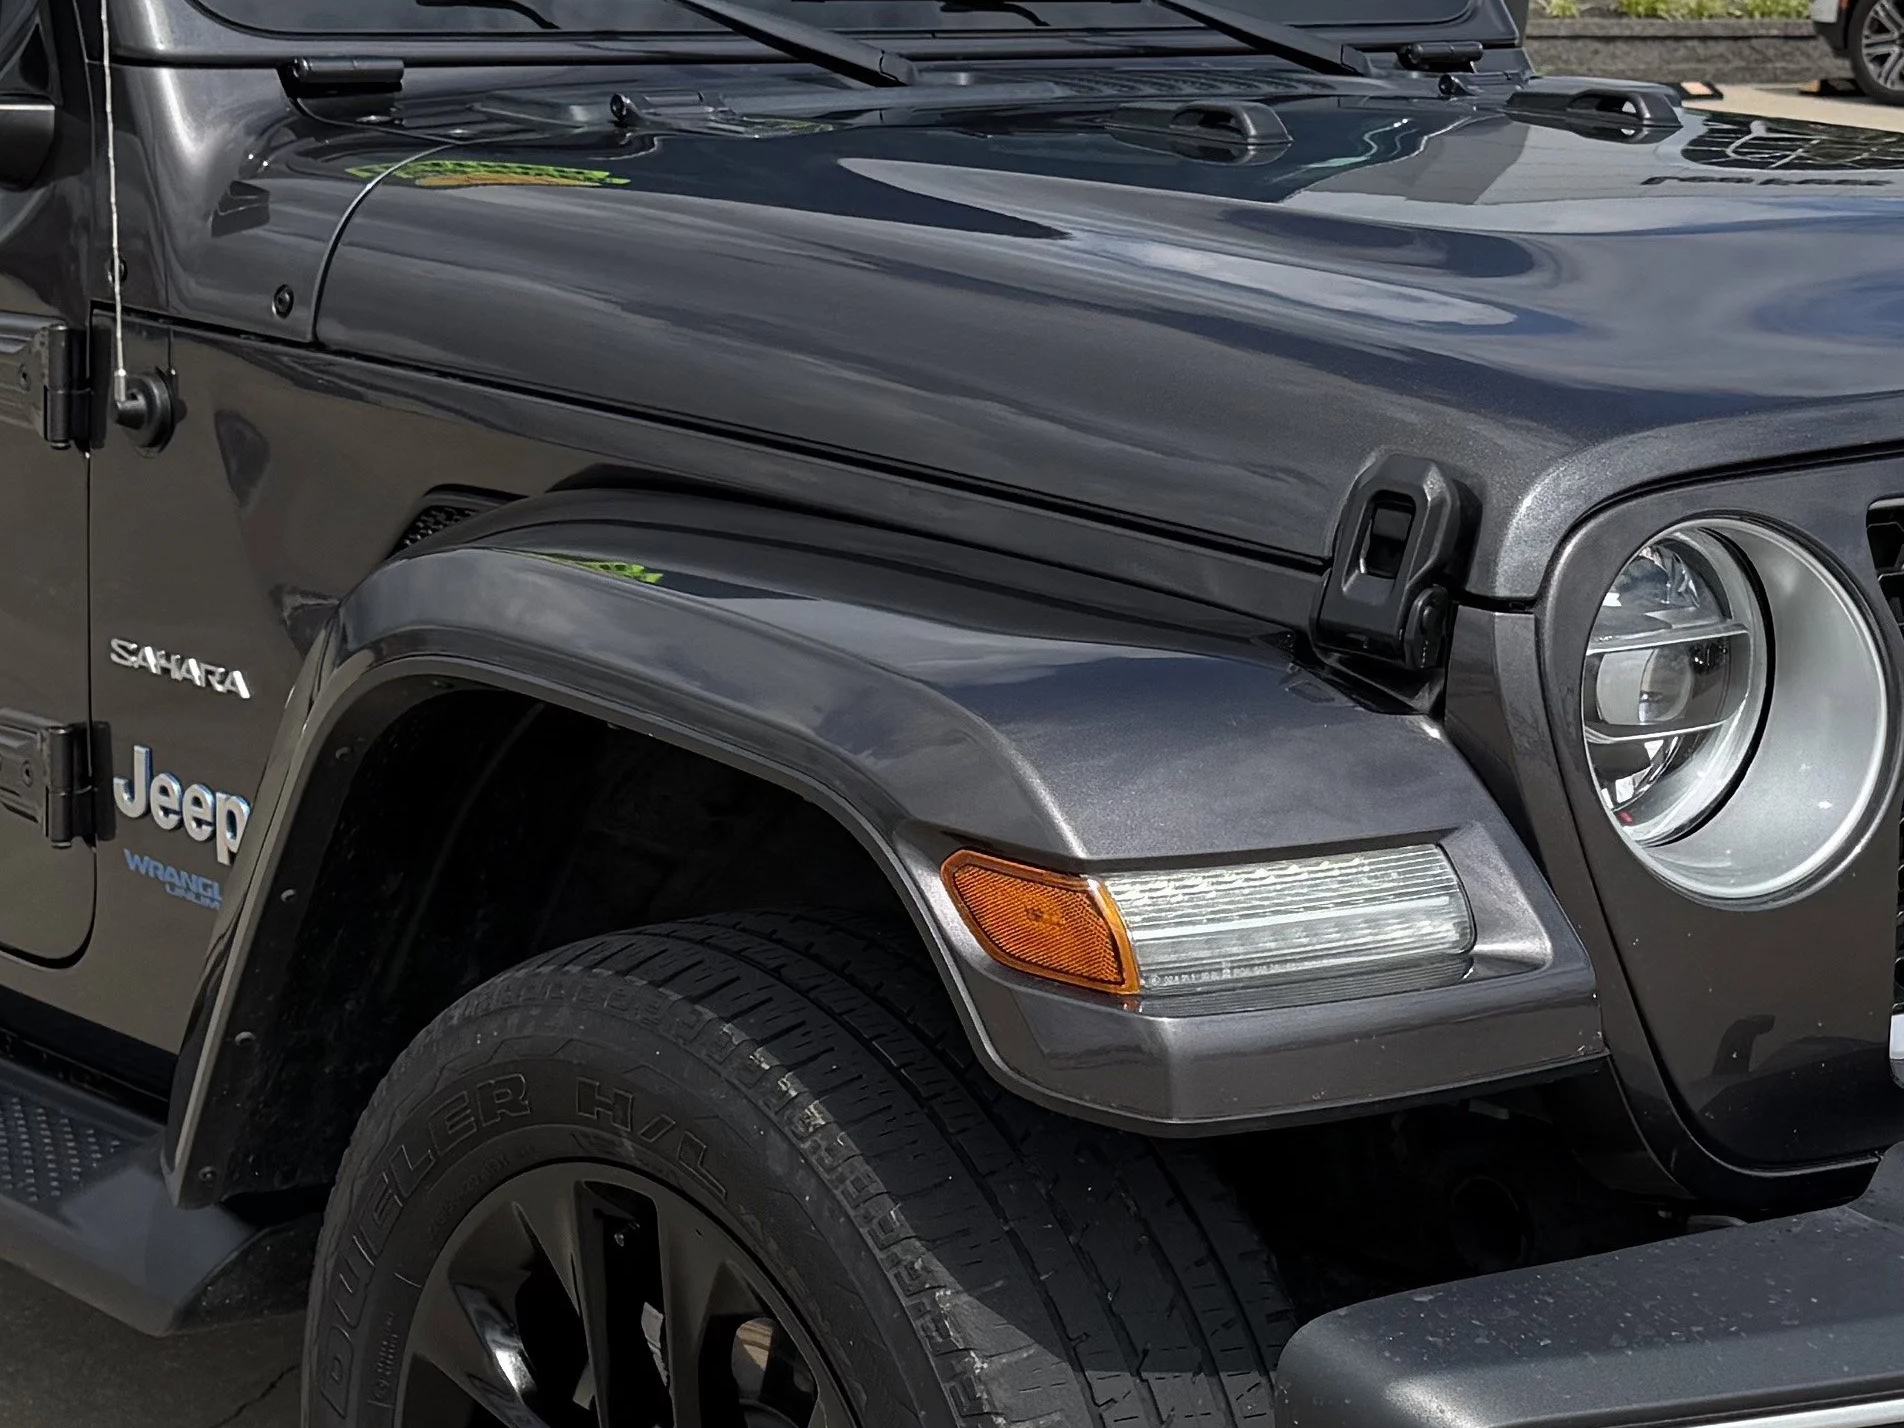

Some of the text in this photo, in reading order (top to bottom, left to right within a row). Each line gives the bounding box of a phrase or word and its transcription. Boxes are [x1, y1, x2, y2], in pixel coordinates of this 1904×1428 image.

[110, 637, 251, 699] SAHARA
[113, 744, 253, 866] Jeep
[123, 848, 222, 902] WRANGL
[318, 1073, 533, 1420] DUELER
